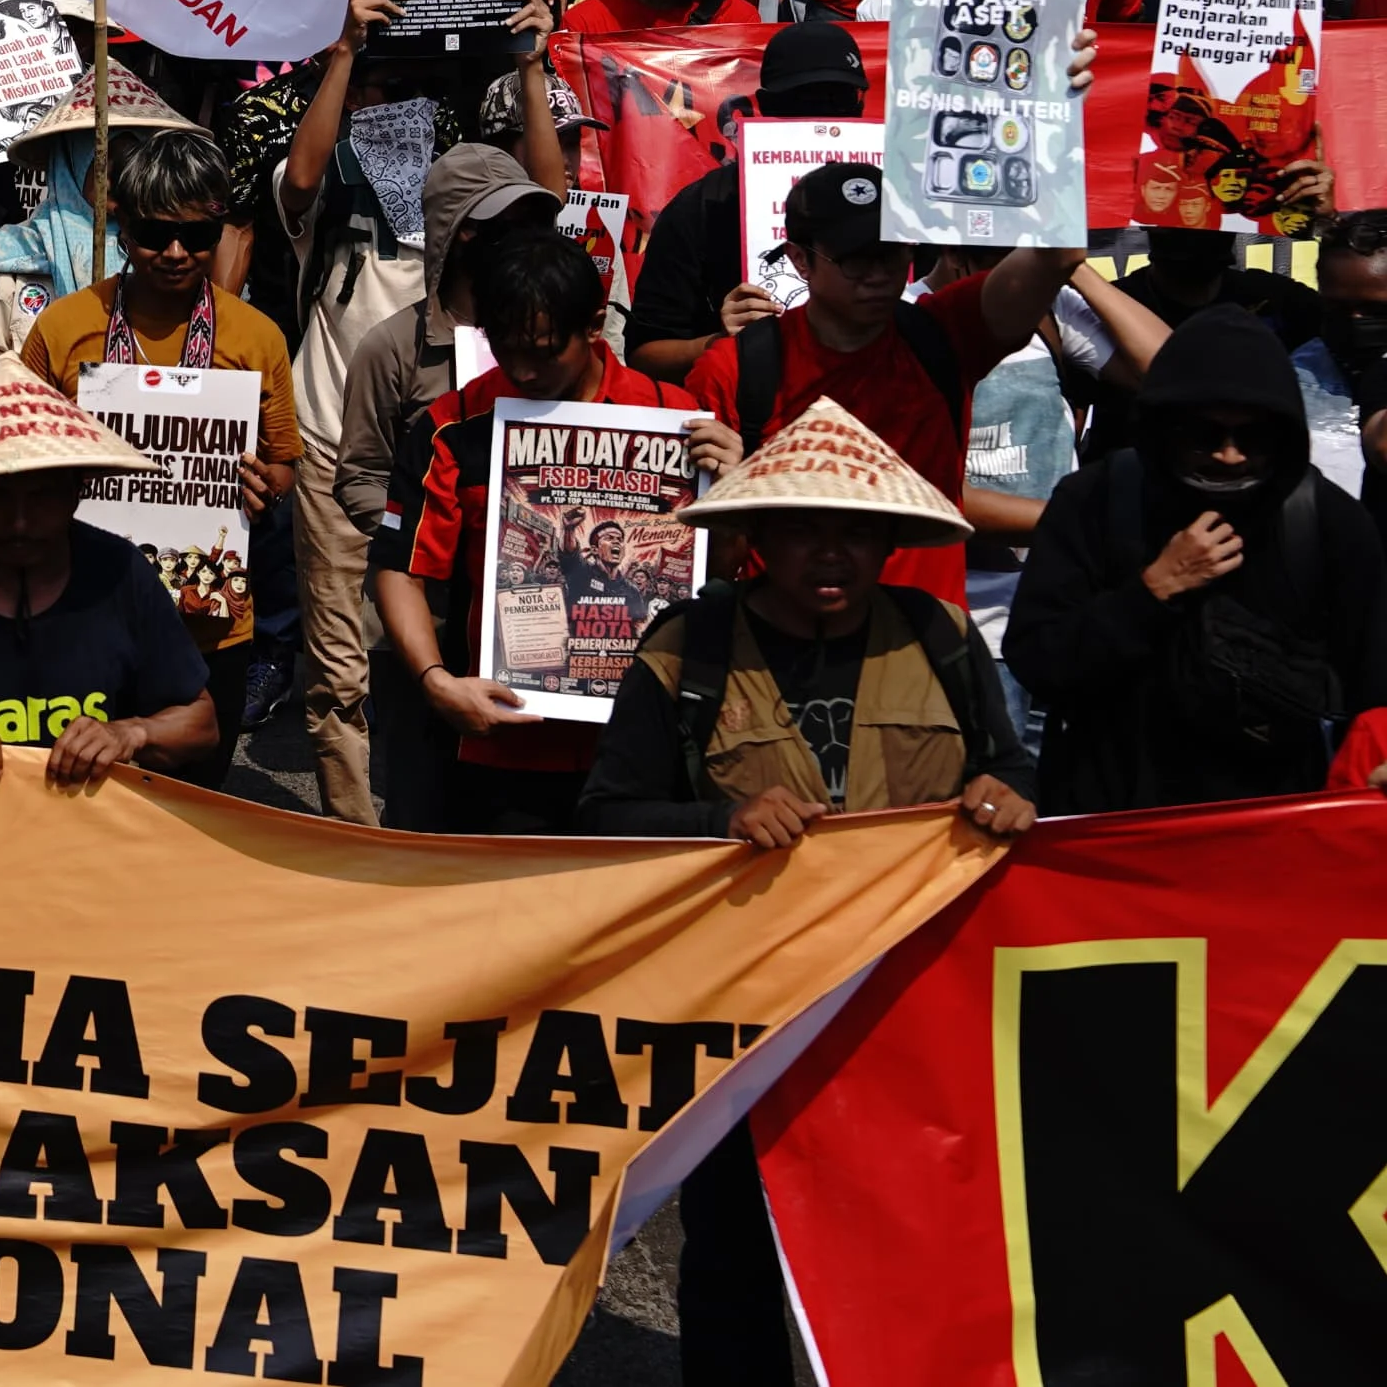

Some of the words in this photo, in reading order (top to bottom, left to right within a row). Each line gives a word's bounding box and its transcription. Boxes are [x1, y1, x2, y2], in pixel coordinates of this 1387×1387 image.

[1166, 4, 1267, 26] Penjarakan
[753, 151, 843, 164] KEMBALIKAN
[508, 429, 572, 467] MAY
[577, 431, 630, 469] DAY
[539, 467, 660, 496] FSBB-KASBI
[127, 480, 243, 510] PEREMPUAN
[519, 595, 543, 604] NOTA
[577, 596, 625, 604] JALANKAN
[505, 604, 561, 614] PEMERIKSAAN
[572, 605, 632, 622] HASIL
[577, 621, 631, 638] NOTA
